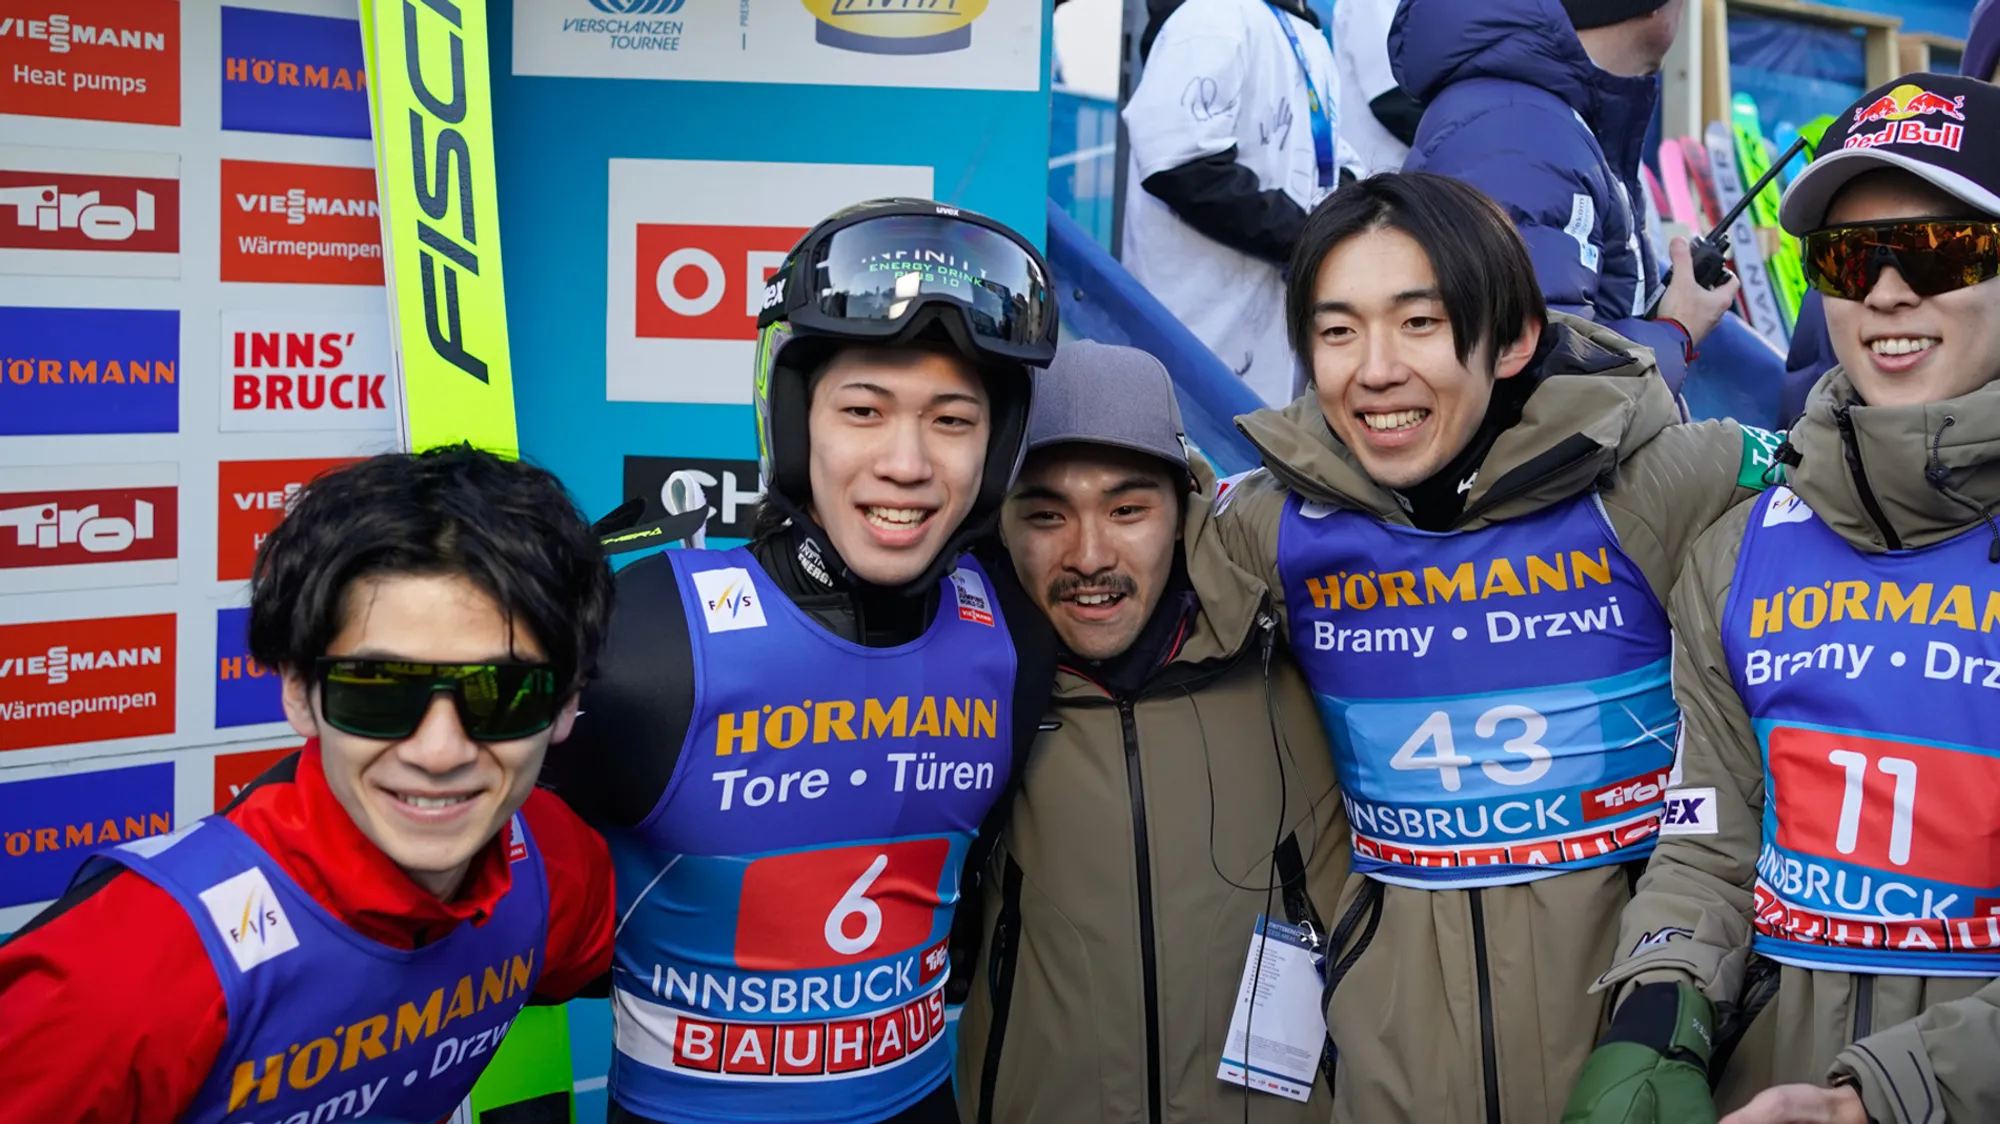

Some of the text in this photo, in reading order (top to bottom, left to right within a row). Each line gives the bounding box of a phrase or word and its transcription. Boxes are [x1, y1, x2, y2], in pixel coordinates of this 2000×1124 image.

[562, 18, 683, 35] VIERSCHANZEN
[610, 35, 679, 51] TOURNEE
[13, 64, 147, 95] Heat pumps
[1897, 121, 1964, 152] Bull
[0, 185, 155, 241] Tirol
[402, 0, 490, 385] FISC
[936, 206, 959, 216] uvex
[238, 236, 381, 261] Wärmepumpen
[869, 261, 983, 288] ENERGY DRINK
[0, 358, 175, 384] ÖRMANN
[233, 375, 386, 410] BRUCK
[0, 499, 153, 553] Tirol
[1305, 547, 1612, 611] HÖRMANN
[708, 595, 752, 612] FIS
[1314, 596, 1625, 658] Bramy Drzwi
[715, 696, 997, 757] HÖRMANN
[1389, 705, 1553, 792] 43
[712, 753, 994, 811] Tore Türen
[1595, 774, 1667, 808] Tirol
[1661, 798, 1705, 824] EX
[1828, 749, 1917, 866] 11
[230, 910, 277, 943] FIS
[824, 854, 889, 955] 6
[652, 955, 914, 1014] INNSBRUCK
[227, 948, 535, 1114] HÖRMANN
[681, 991, 943, 1066] BAUHAUS
